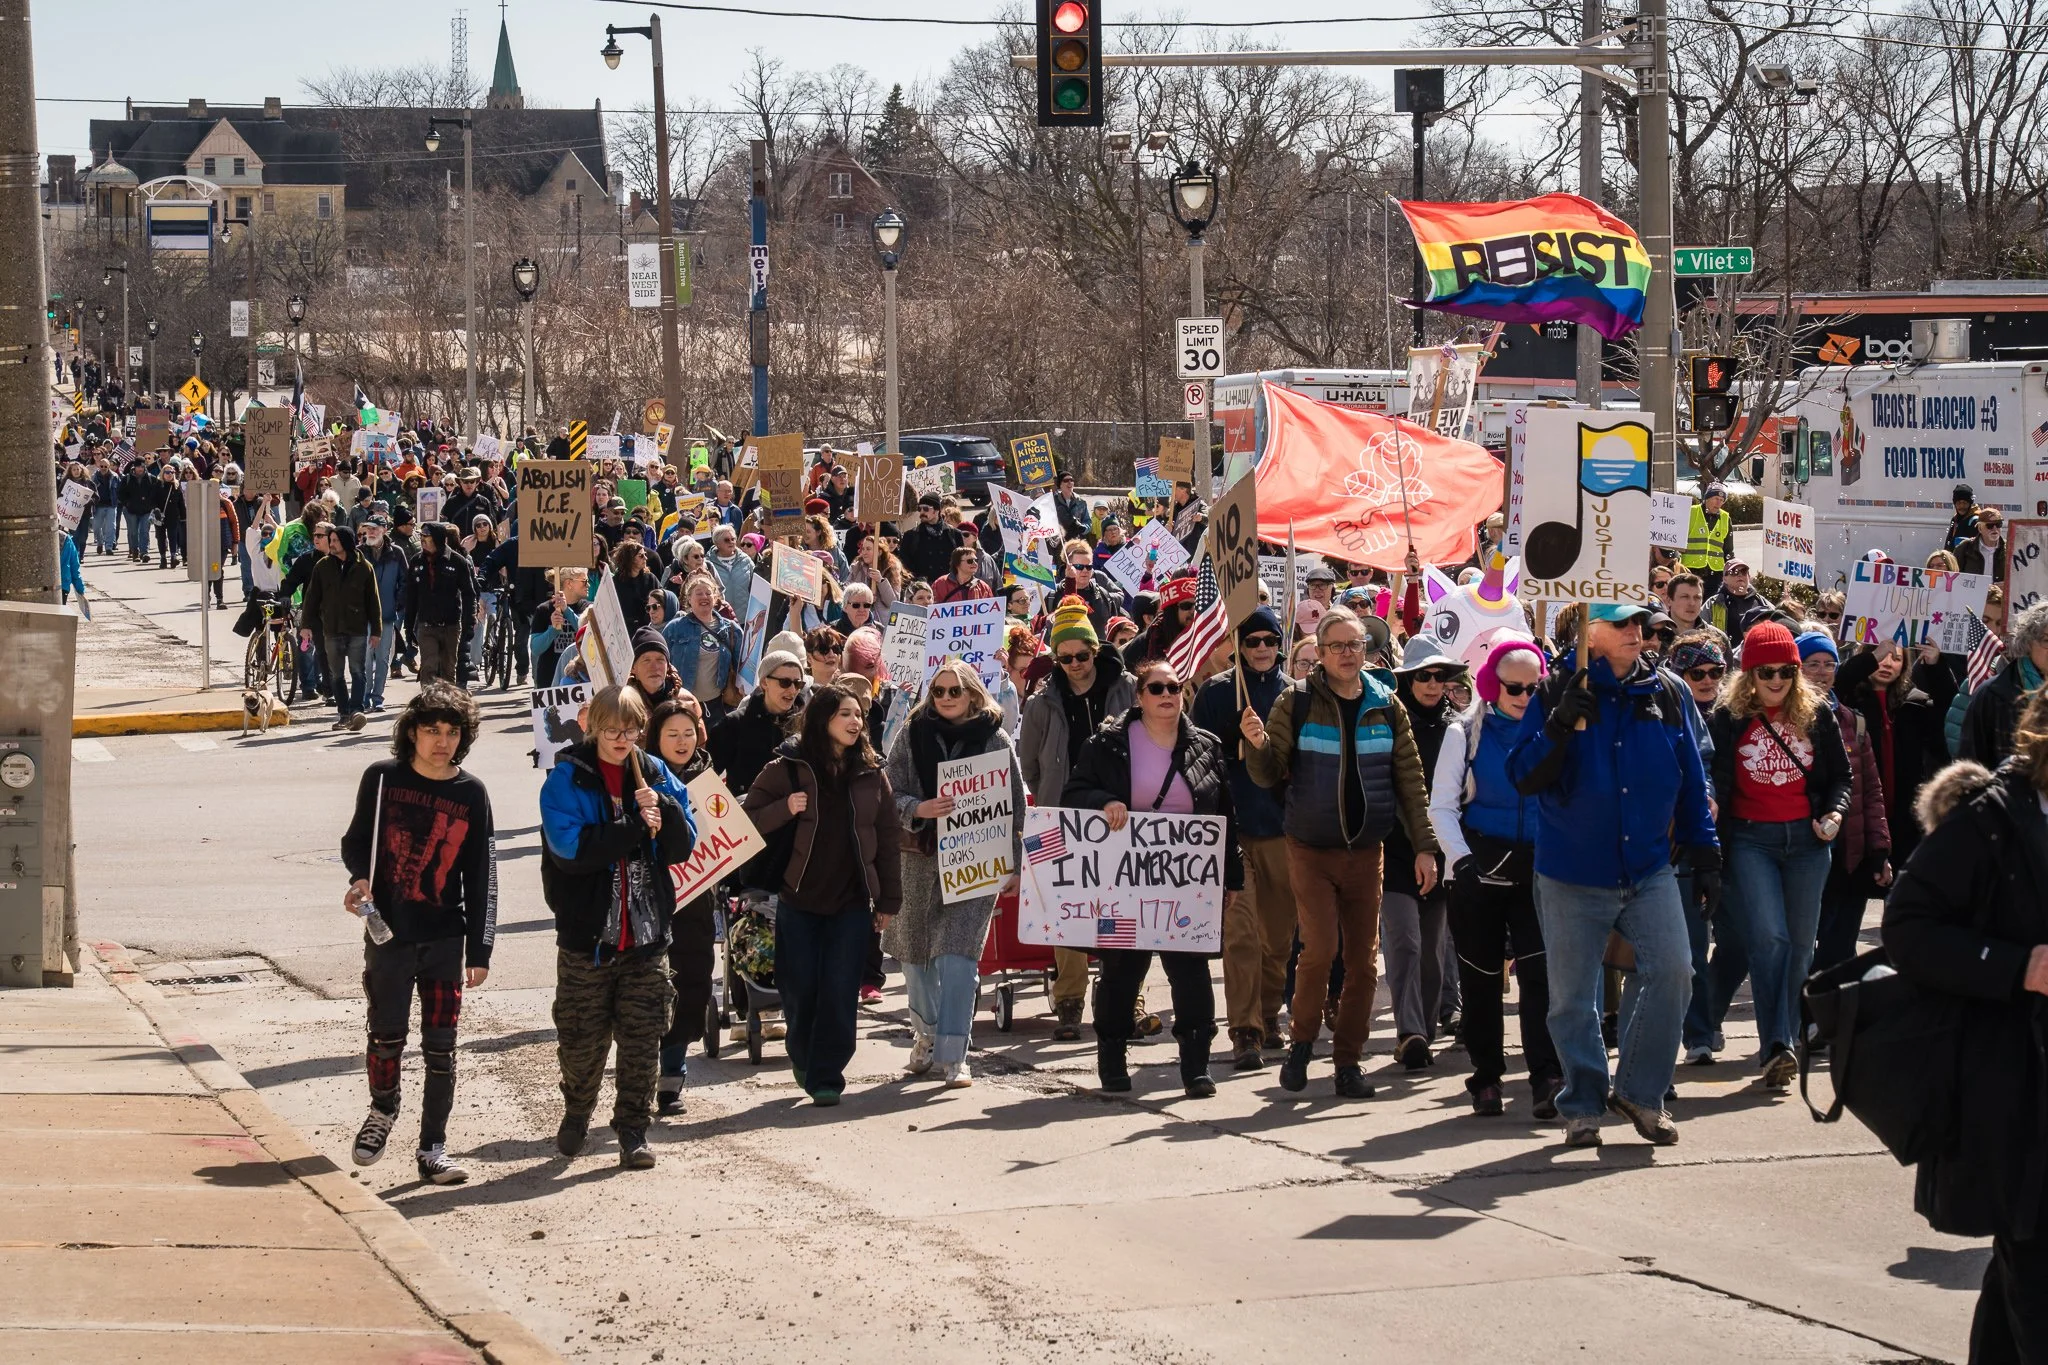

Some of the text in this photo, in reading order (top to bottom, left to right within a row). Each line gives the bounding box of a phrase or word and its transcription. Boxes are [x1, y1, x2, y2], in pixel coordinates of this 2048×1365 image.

[1450, 231, 1631, 290] RESIST
[1676, 252, 1748, 270] W Vliet St
[1182, 325, 1220, 334] SPEED
[1548, 325, 1568, 338] mobile
[1186, 338, 1214, 346] LIMIT
[1184, 349, 1220, 370] 30
[1326, 390, 1385, 402] U-HAUL
[249, 410, 264, 421] NO
[1871, 393, 1998, 432] TACOS EL JAROCHO #3
[250, 435, 264, 444] NO
[1023, 440, 1037, 449] NO
[252, 448, 272, 456] KKK
[1018, 446, 1046, 457] KINGS
[250, 460, 264, 469] NO
[863, 458, 892, 480] NO
[1020, 456, 1049, 467] AMERICA
[1884, 447, 1966, 479] FOOD TRUCK
[251, 470, 288, 480] FASCIST
[520, 467, 586, 492] ABOLISH
[768, 472, 792, 488] NO
[256, 480, 276, 489] USA
[863, 479, 900, 499] KINGS
[1156, 487, 1171, 496] RUL
[71, 500, 83, 508] the
[537, 490, 574, 514] I.C.E.
[862, 499, 899, 514] NO ICE
[1662, 497, 1674, 509] HE
[1661, 516, 1676, 525] THIS
[1777, 510, 1802, 528] LOVE
[530, 512, 581, 548] NOW!
[1216, 504, 1240, 561] NO
[2013, 543, 2040, 571] NO
[1855, 562, 1976, 592] LIBERTY and
[1524, 578, 1646, 601] SINGERS
[930, 601, 1000, 620] AMERICA
[1880, 587, 1933, 617] JUSTICE
[932, 623, 995, 640] IS BUILT
[1840, 615, 1879, 644] FOR
[948, 640, 972, 652] ON
[532, 686, 584, 709] KING
[943, 763, 973, 780] WHEN
[940, 767, 1009, 798] CRUELTY
[388, 787, 432, 809] CHEMICAL
[957, 794, 987, 809] COMES
[946, 800, 1013, 832] NORMAL
[940, 824, 1007, 850] COMPASSION
[1059, 810, 1221, 848] NO KINGS
[669, 825, 748, 891] ORMAL.
[941, 849, 975, 867] LOOKS
[943, 856, 1014, 894] RADICAL
[1052, 850, 1220, 888] IN AMERICA
[1060, 898, 1191, 932] SINCE 1776
[1193, 921, 1210, 932] ever
